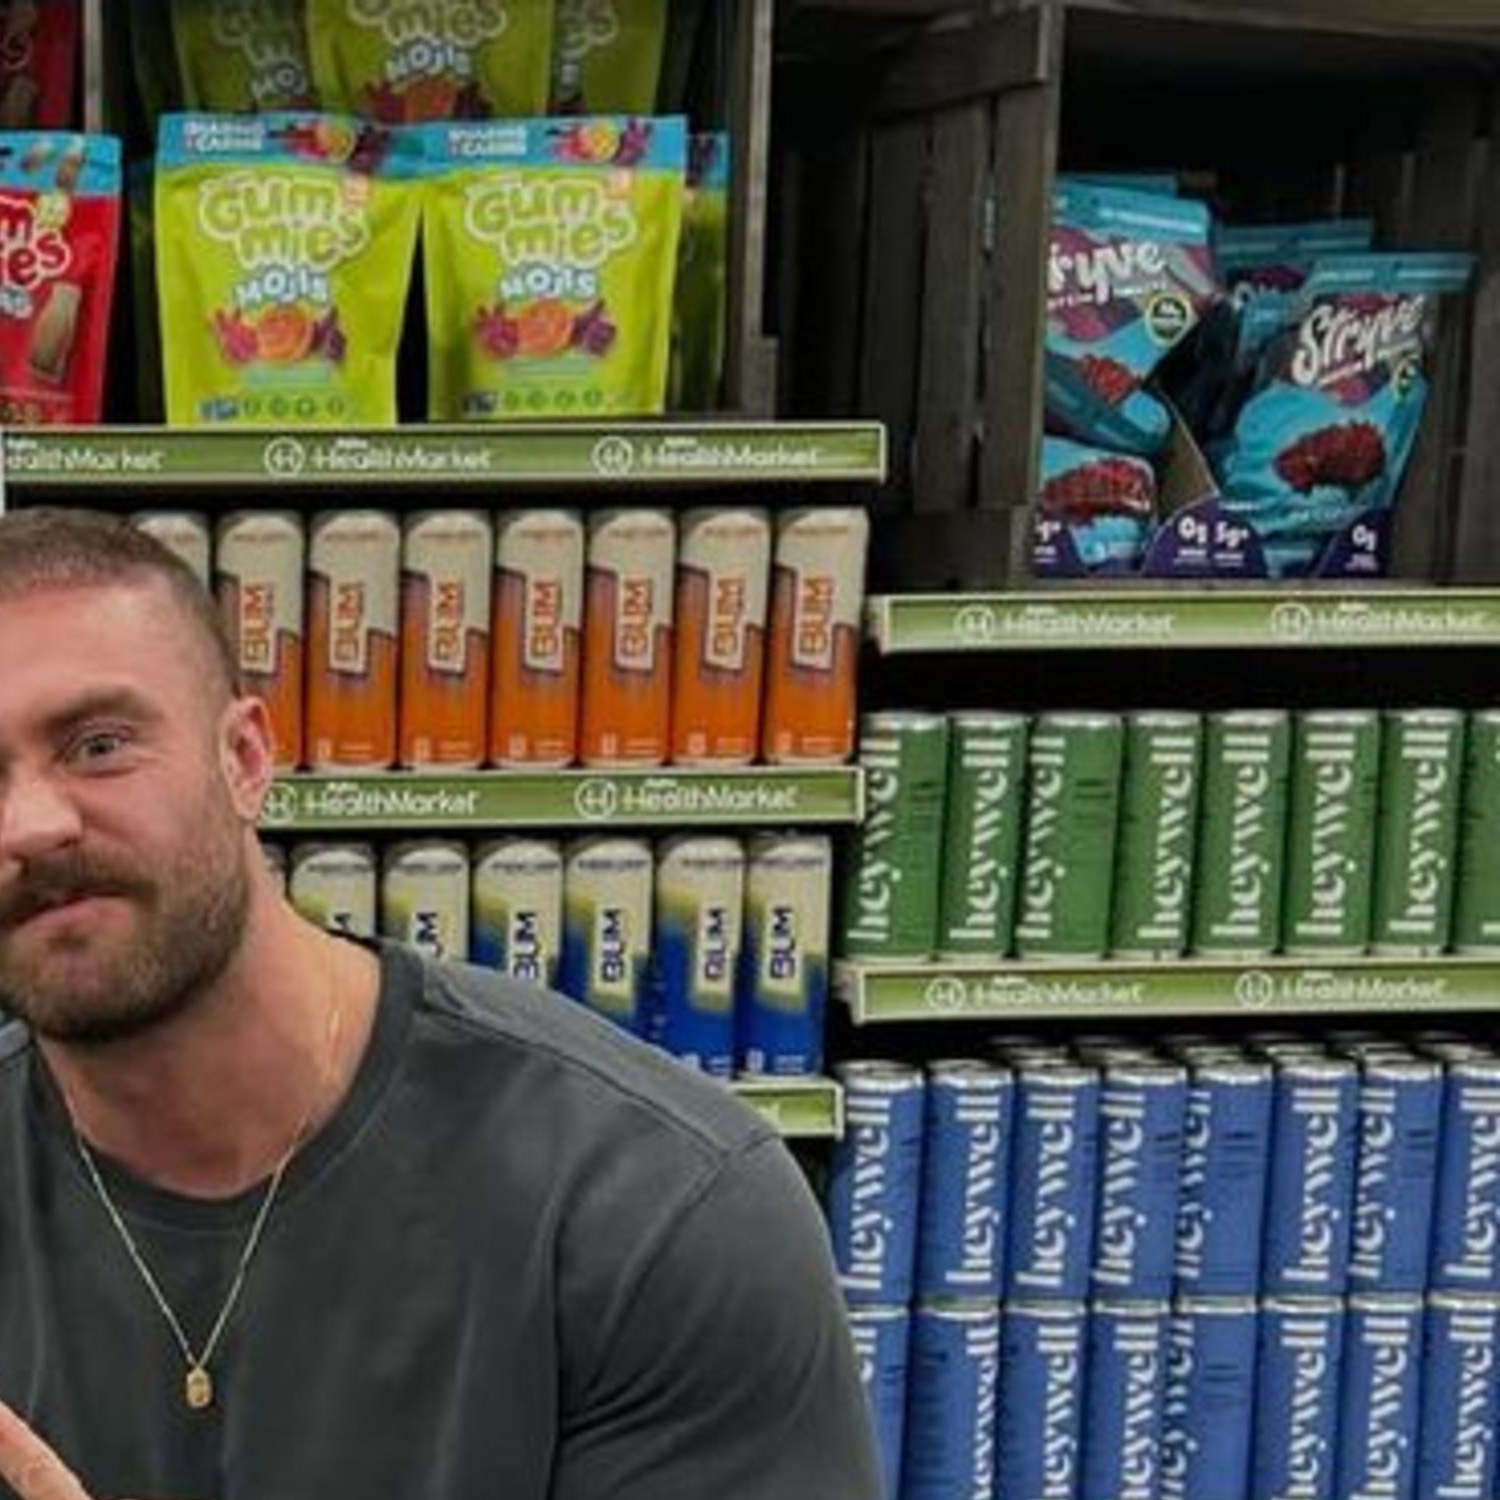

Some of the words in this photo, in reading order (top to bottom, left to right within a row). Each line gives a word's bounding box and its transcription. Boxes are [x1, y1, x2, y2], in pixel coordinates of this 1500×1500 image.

[6, 443, 161, 469] ealthMarket
[243, 583, 274, 662] BUM
[333, 583, 364, 663] BUM
[433, 583, 463, 663] BUM
[528, 581, 560, 660] BUM
[620, 580, 653, 659] BUM
[712, 578, 745, 658] BUM
[800, 577, 832, 658] BUM
[950, 740, 1011, 938] heywell
[1016, 737, 1066, 937] heywell
[1137, 736, 1195, 938] heywell
[1211, 736, 1270, 935] heywell
[1296, 733, 1356, 934] heywell
[1388, 730, 1449, 931] heywell
[603, 909, 626, 982] BUM
[704, 908, 728, 980] BUM
[770, 907, 795, 978] BUM
[837, 1097, 894, 1289] heywell
[945, 1095, 1000, 1282] heywell
[1015, 1094, 1076, 1285] heywell
[1093, 1092, 1146, 1284] heywell
[1283, 1088, 1340, 1280] heywell
[1349, 1088, 1396, 1278] heywell
[1444, 1087, 1500, 1277] heywell
[1437, 1316, 1494, 1497] heywell
